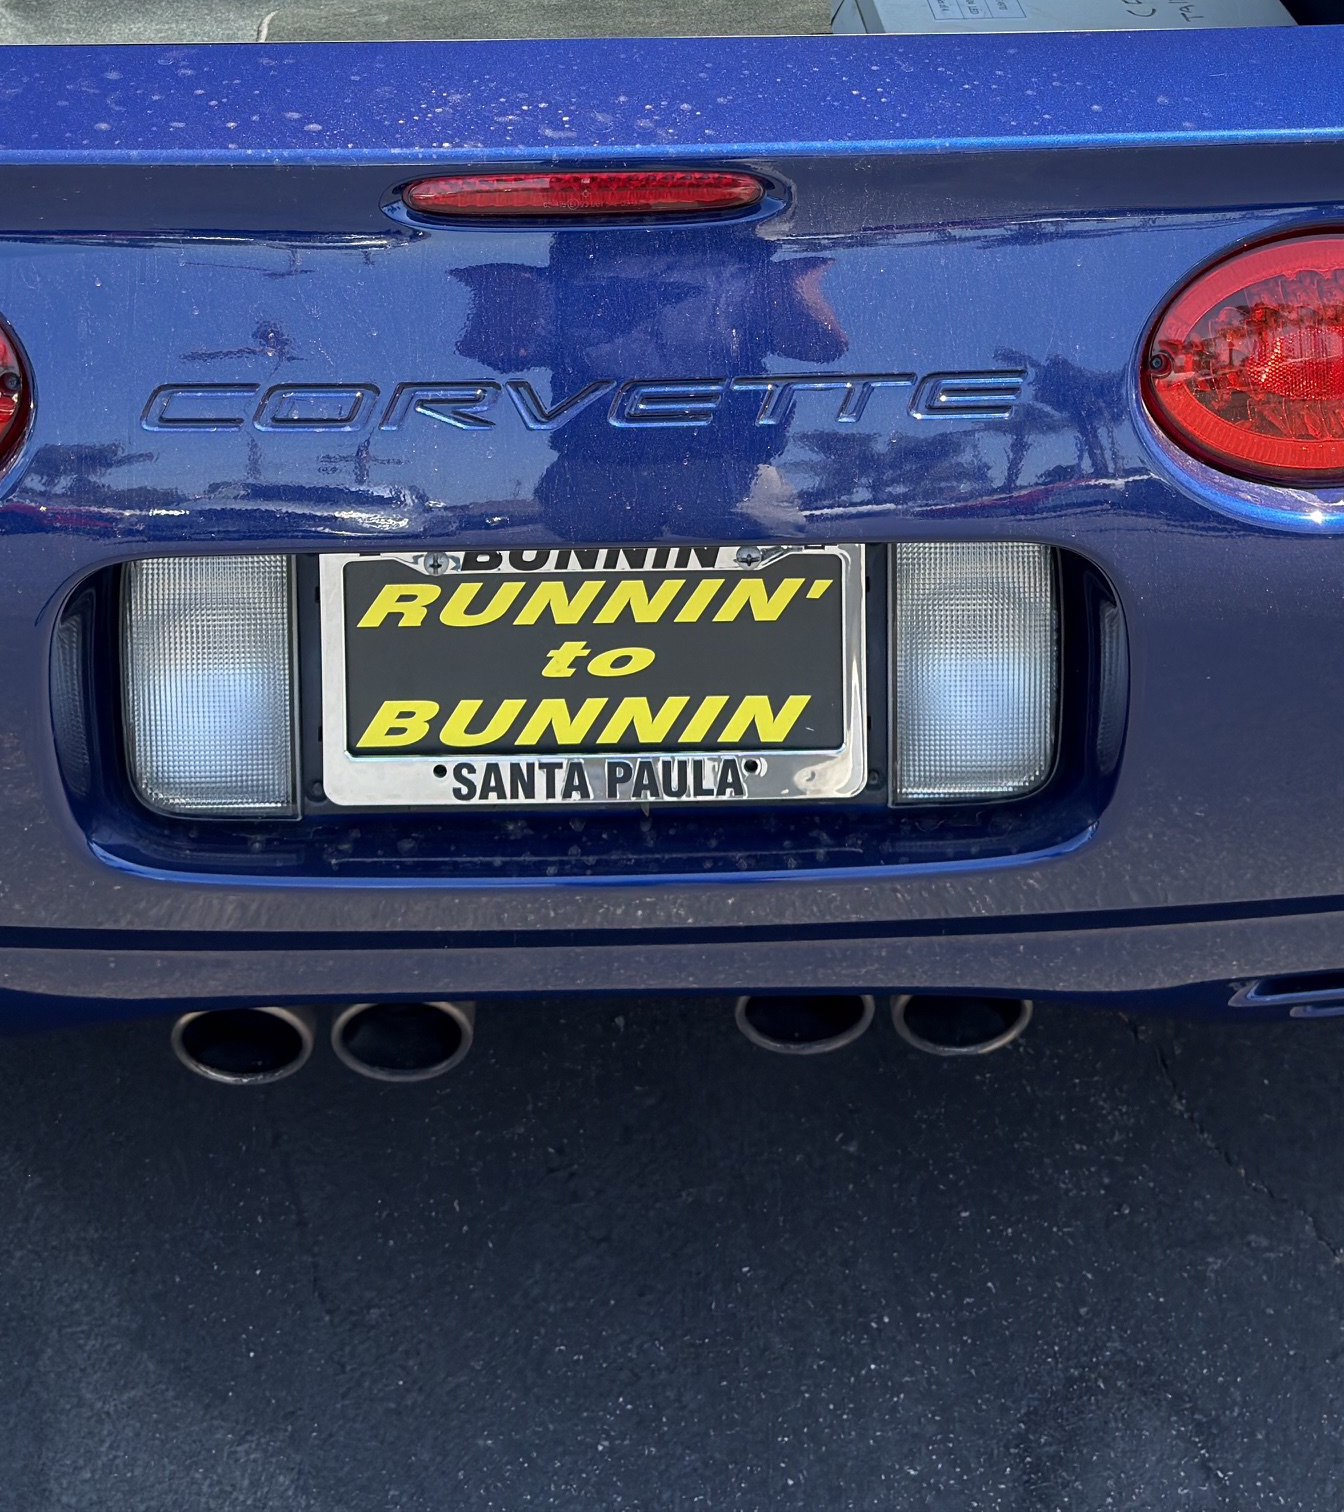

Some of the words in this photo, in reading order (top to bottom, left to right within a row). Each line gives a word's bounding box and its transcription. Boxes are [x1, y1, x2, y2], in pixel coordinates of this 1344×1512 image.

[141, 369, 1027, 432] CORVETTE
[357, 577, 834, 628] RUNNIN'
[540, 641, 657, 678] to
[356, 694, 812, 748] BUNNIN
[451, 759, 592, 801] SANTA
[605, 758, 746, 799] PAULA
